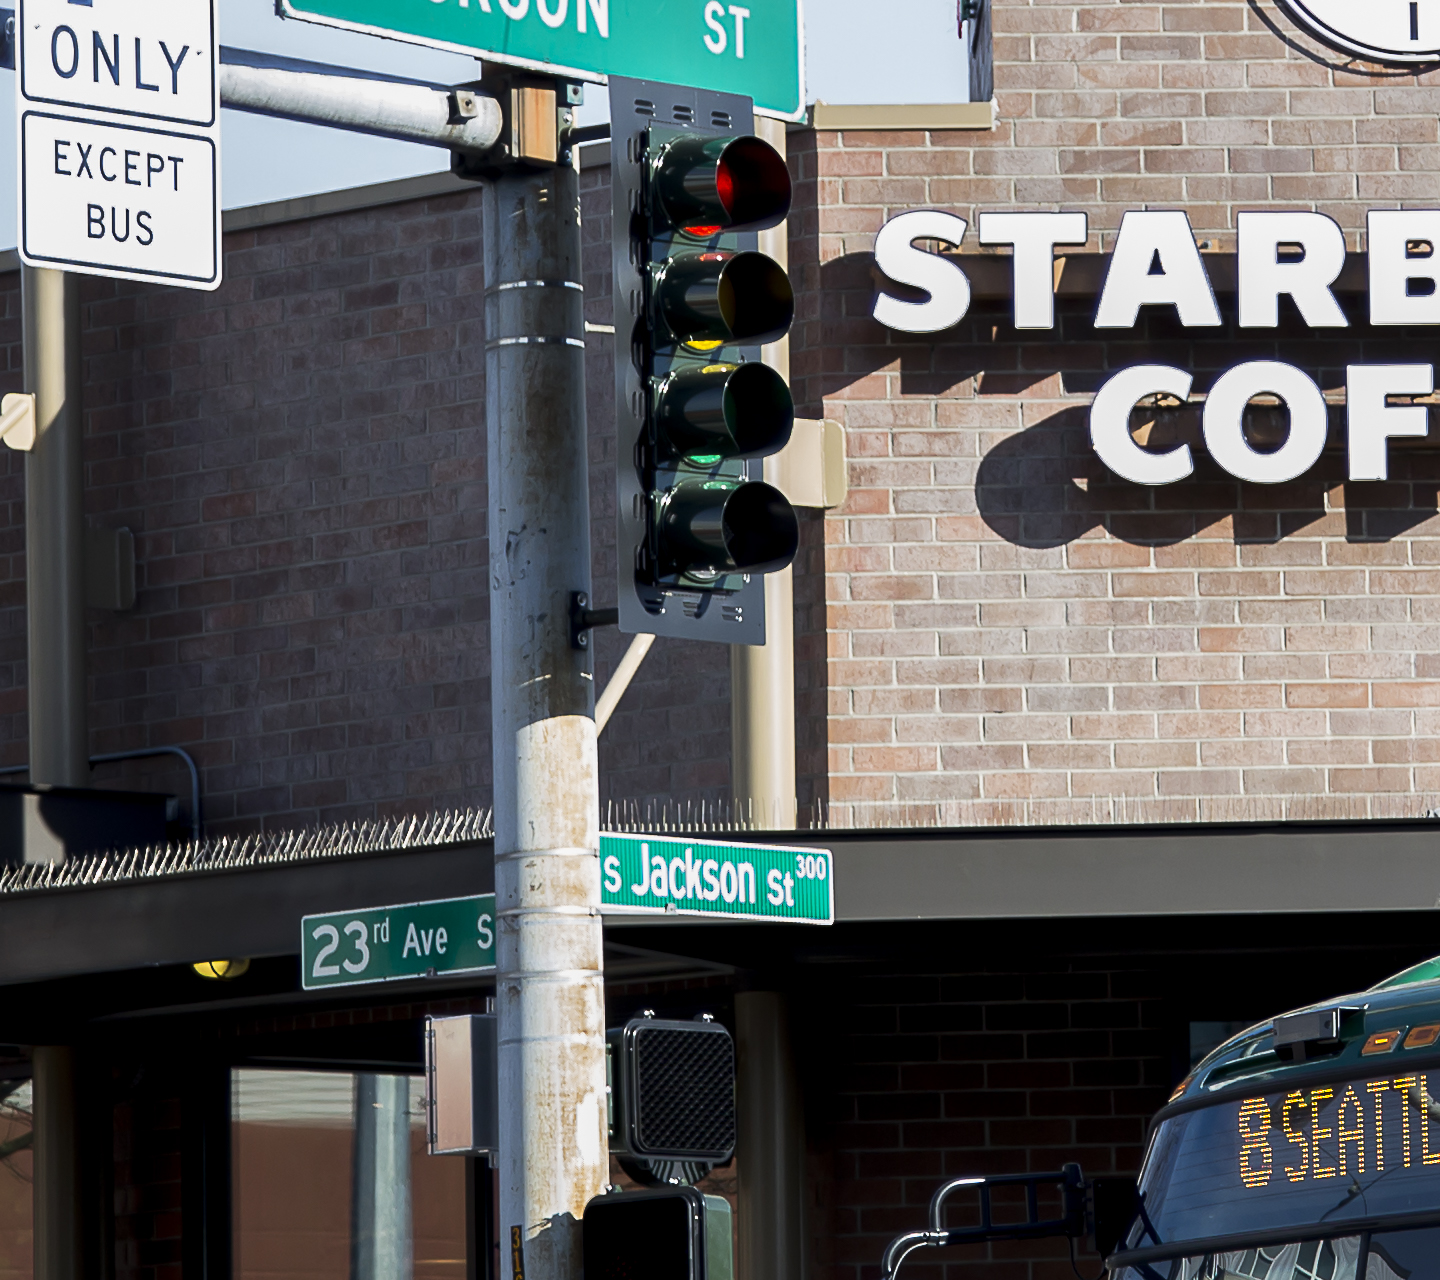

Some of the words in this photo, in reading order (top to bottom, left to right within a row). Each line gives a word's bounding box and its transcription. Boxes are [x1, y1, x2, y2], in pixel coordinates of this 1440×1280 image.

[50, 24, 190, 95] ONLY
[703, 0, 751, 60] ST
[53, 138, 184, 192] EXCEPT
[86, 202, 154, 246] BUS
[630, 842, 756, 906] Jackson
[795, 853, 827, 882] 300
[311, 915, 390, 979] 23rd
[401, 922, 449, 960] Ave
[476, 913, 494, 951] S
[1238, 1097, 1273, 1189] 8
